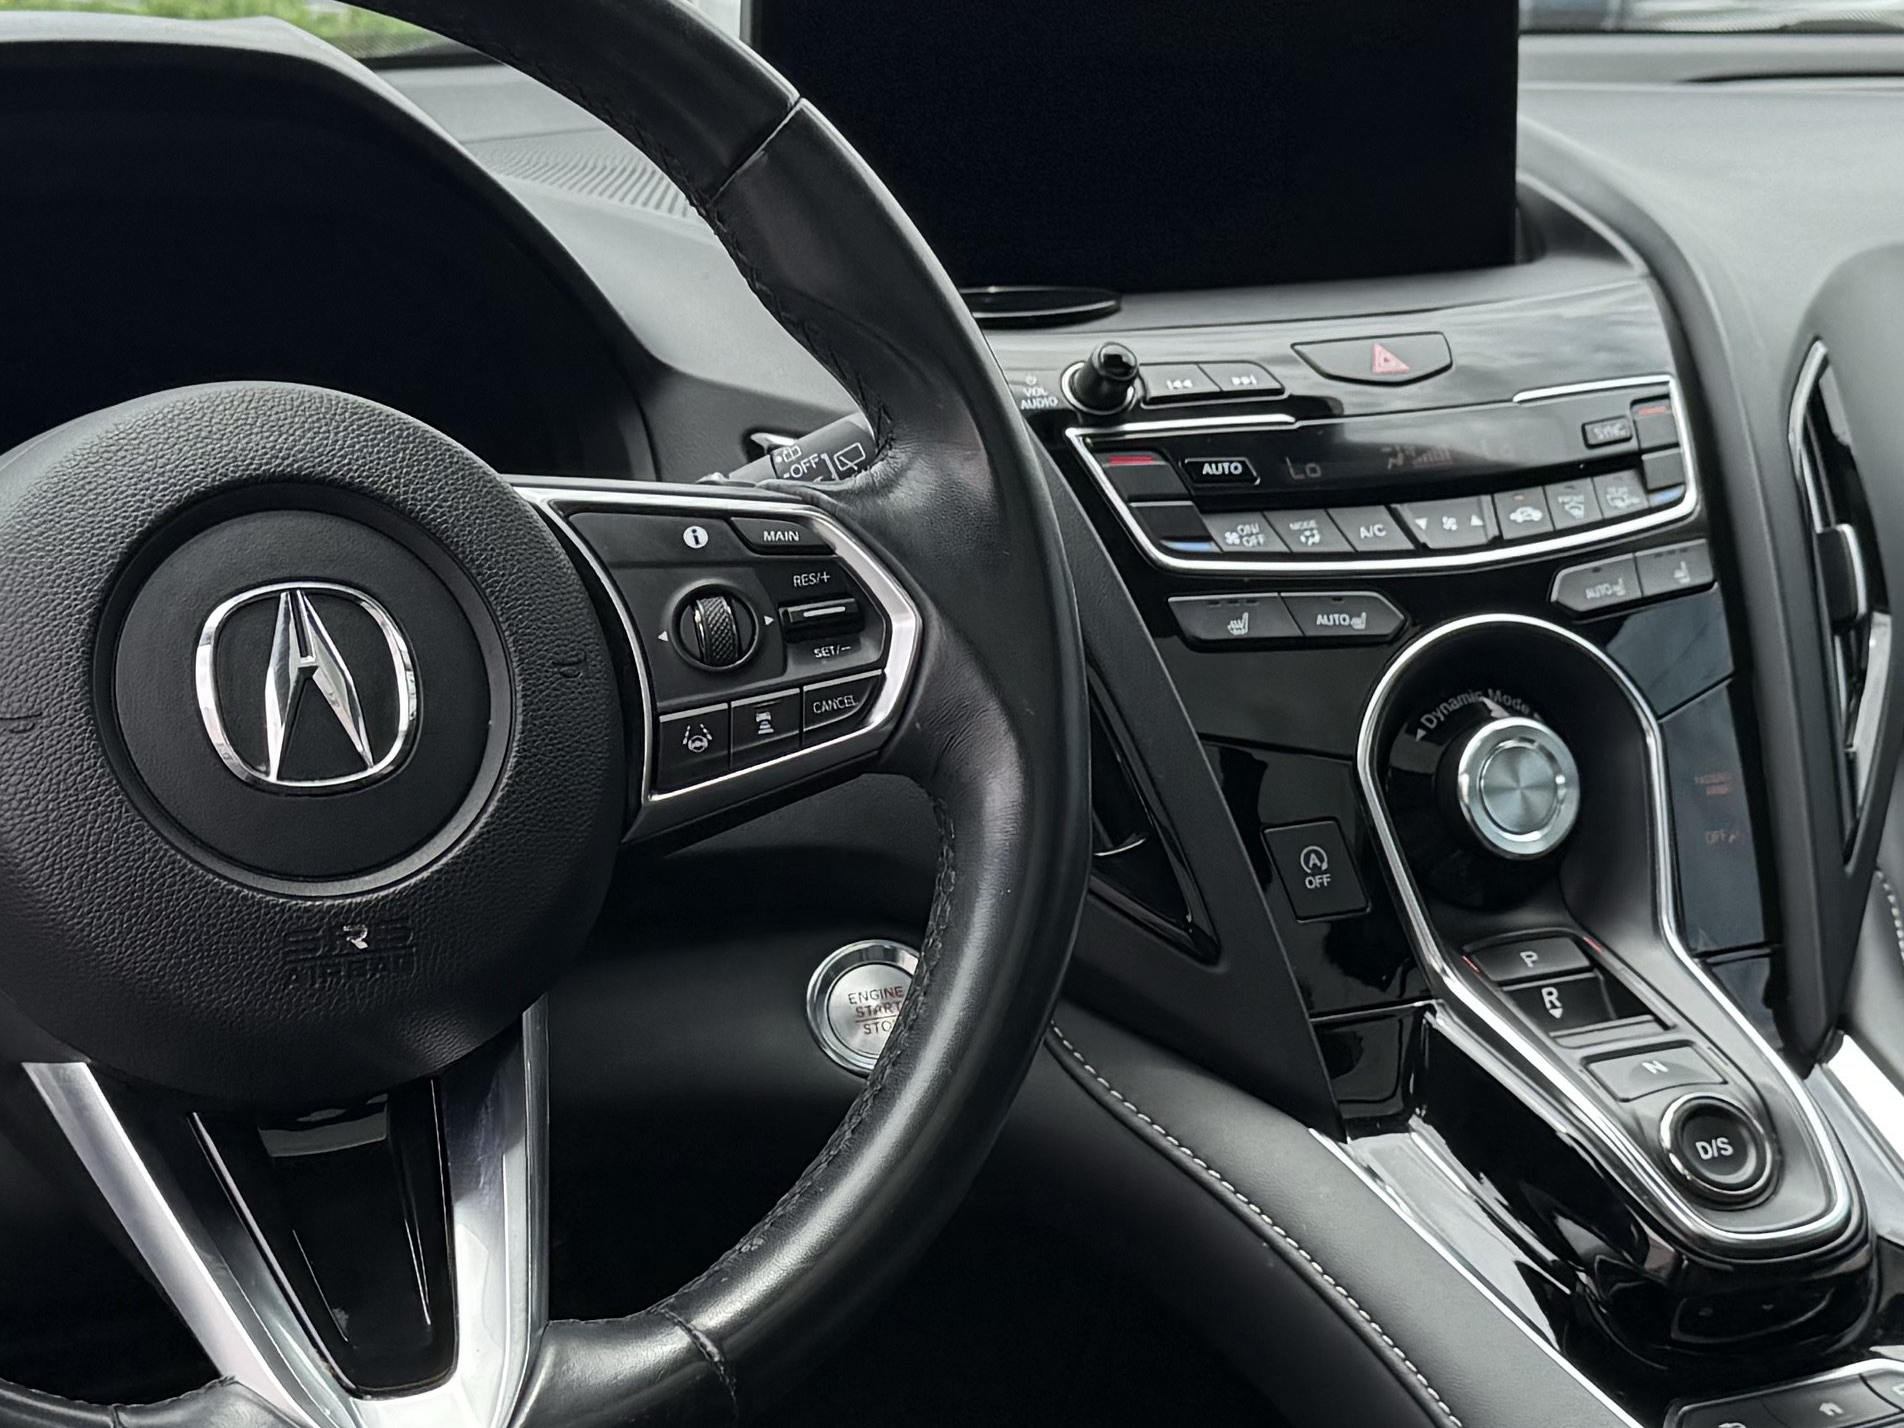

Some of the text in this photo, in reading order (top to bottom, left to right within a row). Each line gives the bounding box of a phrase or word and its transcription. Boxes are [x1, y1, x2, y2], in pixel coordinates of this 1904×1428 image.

[1023, 386, 1047, 398] VOL
[1020, 397, 1058, 410] AUDIO
[790, 453, 819, 478] OFF
[1202, 461, 1243, 476] AUTO
[763, 529, 799, 543] MAIN
[1359, 524, 1387, 539] A/C
[1242, 534, 1266, 548] OFF
[793, 570, 832, 589] RES/+
[1316, 613, 1350, 627] AUTO
[812, 693, 860, 714] CANCEL
[1420, 688, 1531, 729] Dynamic Mode
[1305, 873, 1331, 889] OFF
[1520, 951, 1538, 968] P
[848, 986, 904, 1005] ENGINE
[1541, 986, 1561, 1010] R
[855, 1000, 902, 1018] START
[864, 1020, 896, 1036] STO
[1642, 1060, 1667, 1077] N
[1695, 1136, 1734, 1160] D/S
